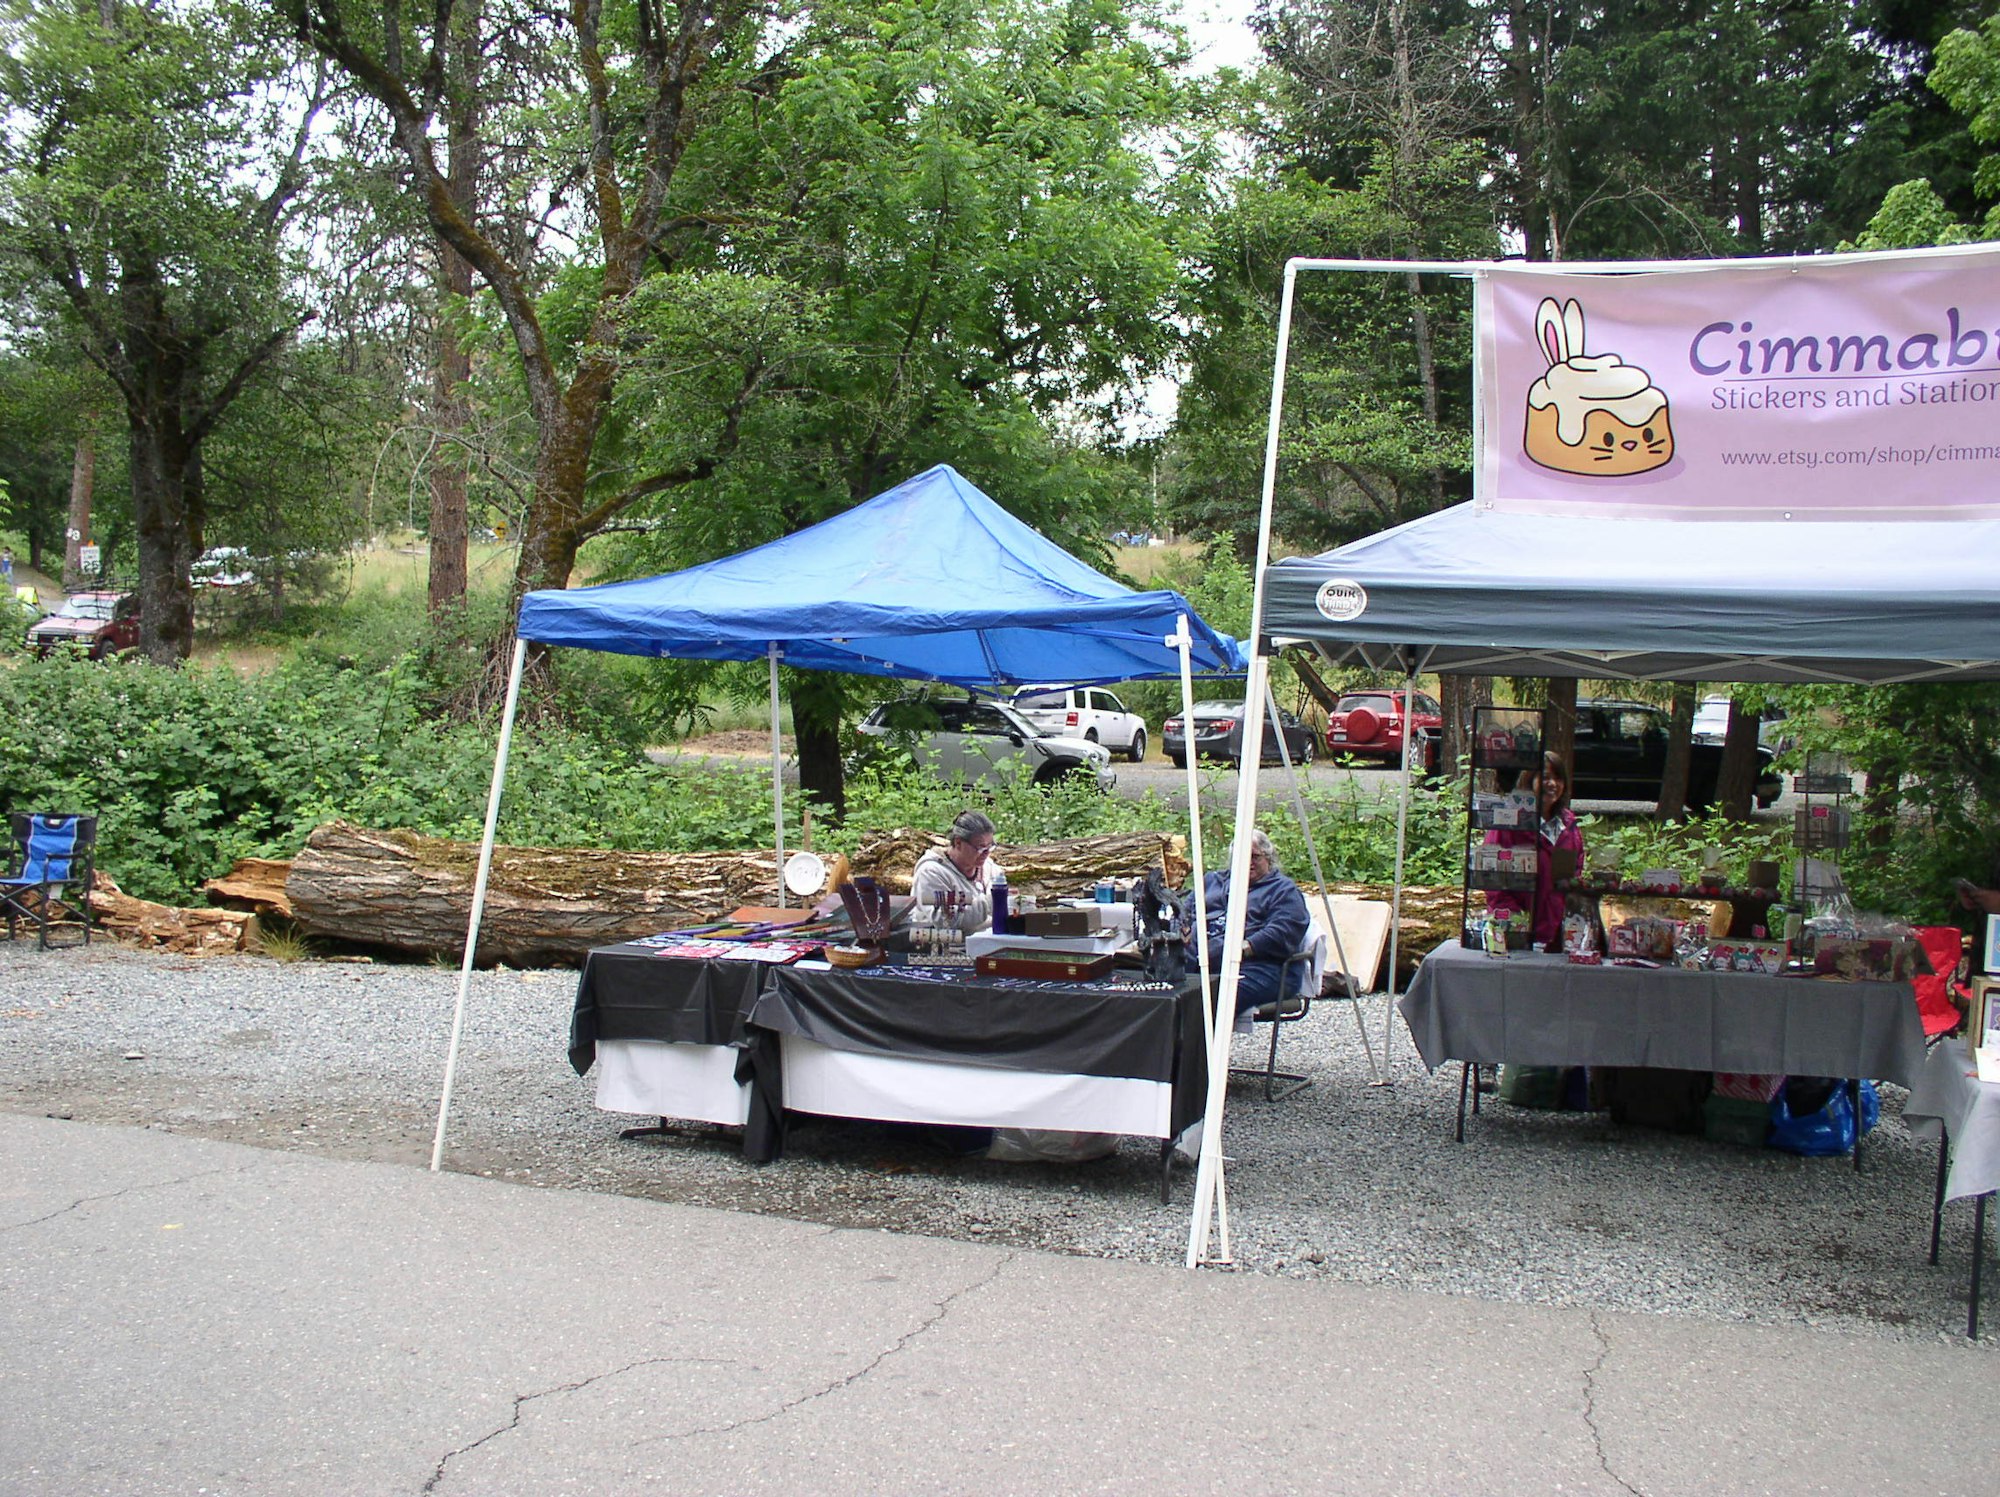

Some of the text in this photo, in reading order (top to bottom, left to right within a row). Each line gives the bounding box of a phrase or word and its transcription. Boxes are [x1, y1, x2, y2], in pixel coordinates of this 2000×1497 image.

[1711, 385, 1826, 410] Stickers
[1835, 382, 1891, 407] and
[1326, 588, 1356, 598] QUIK
